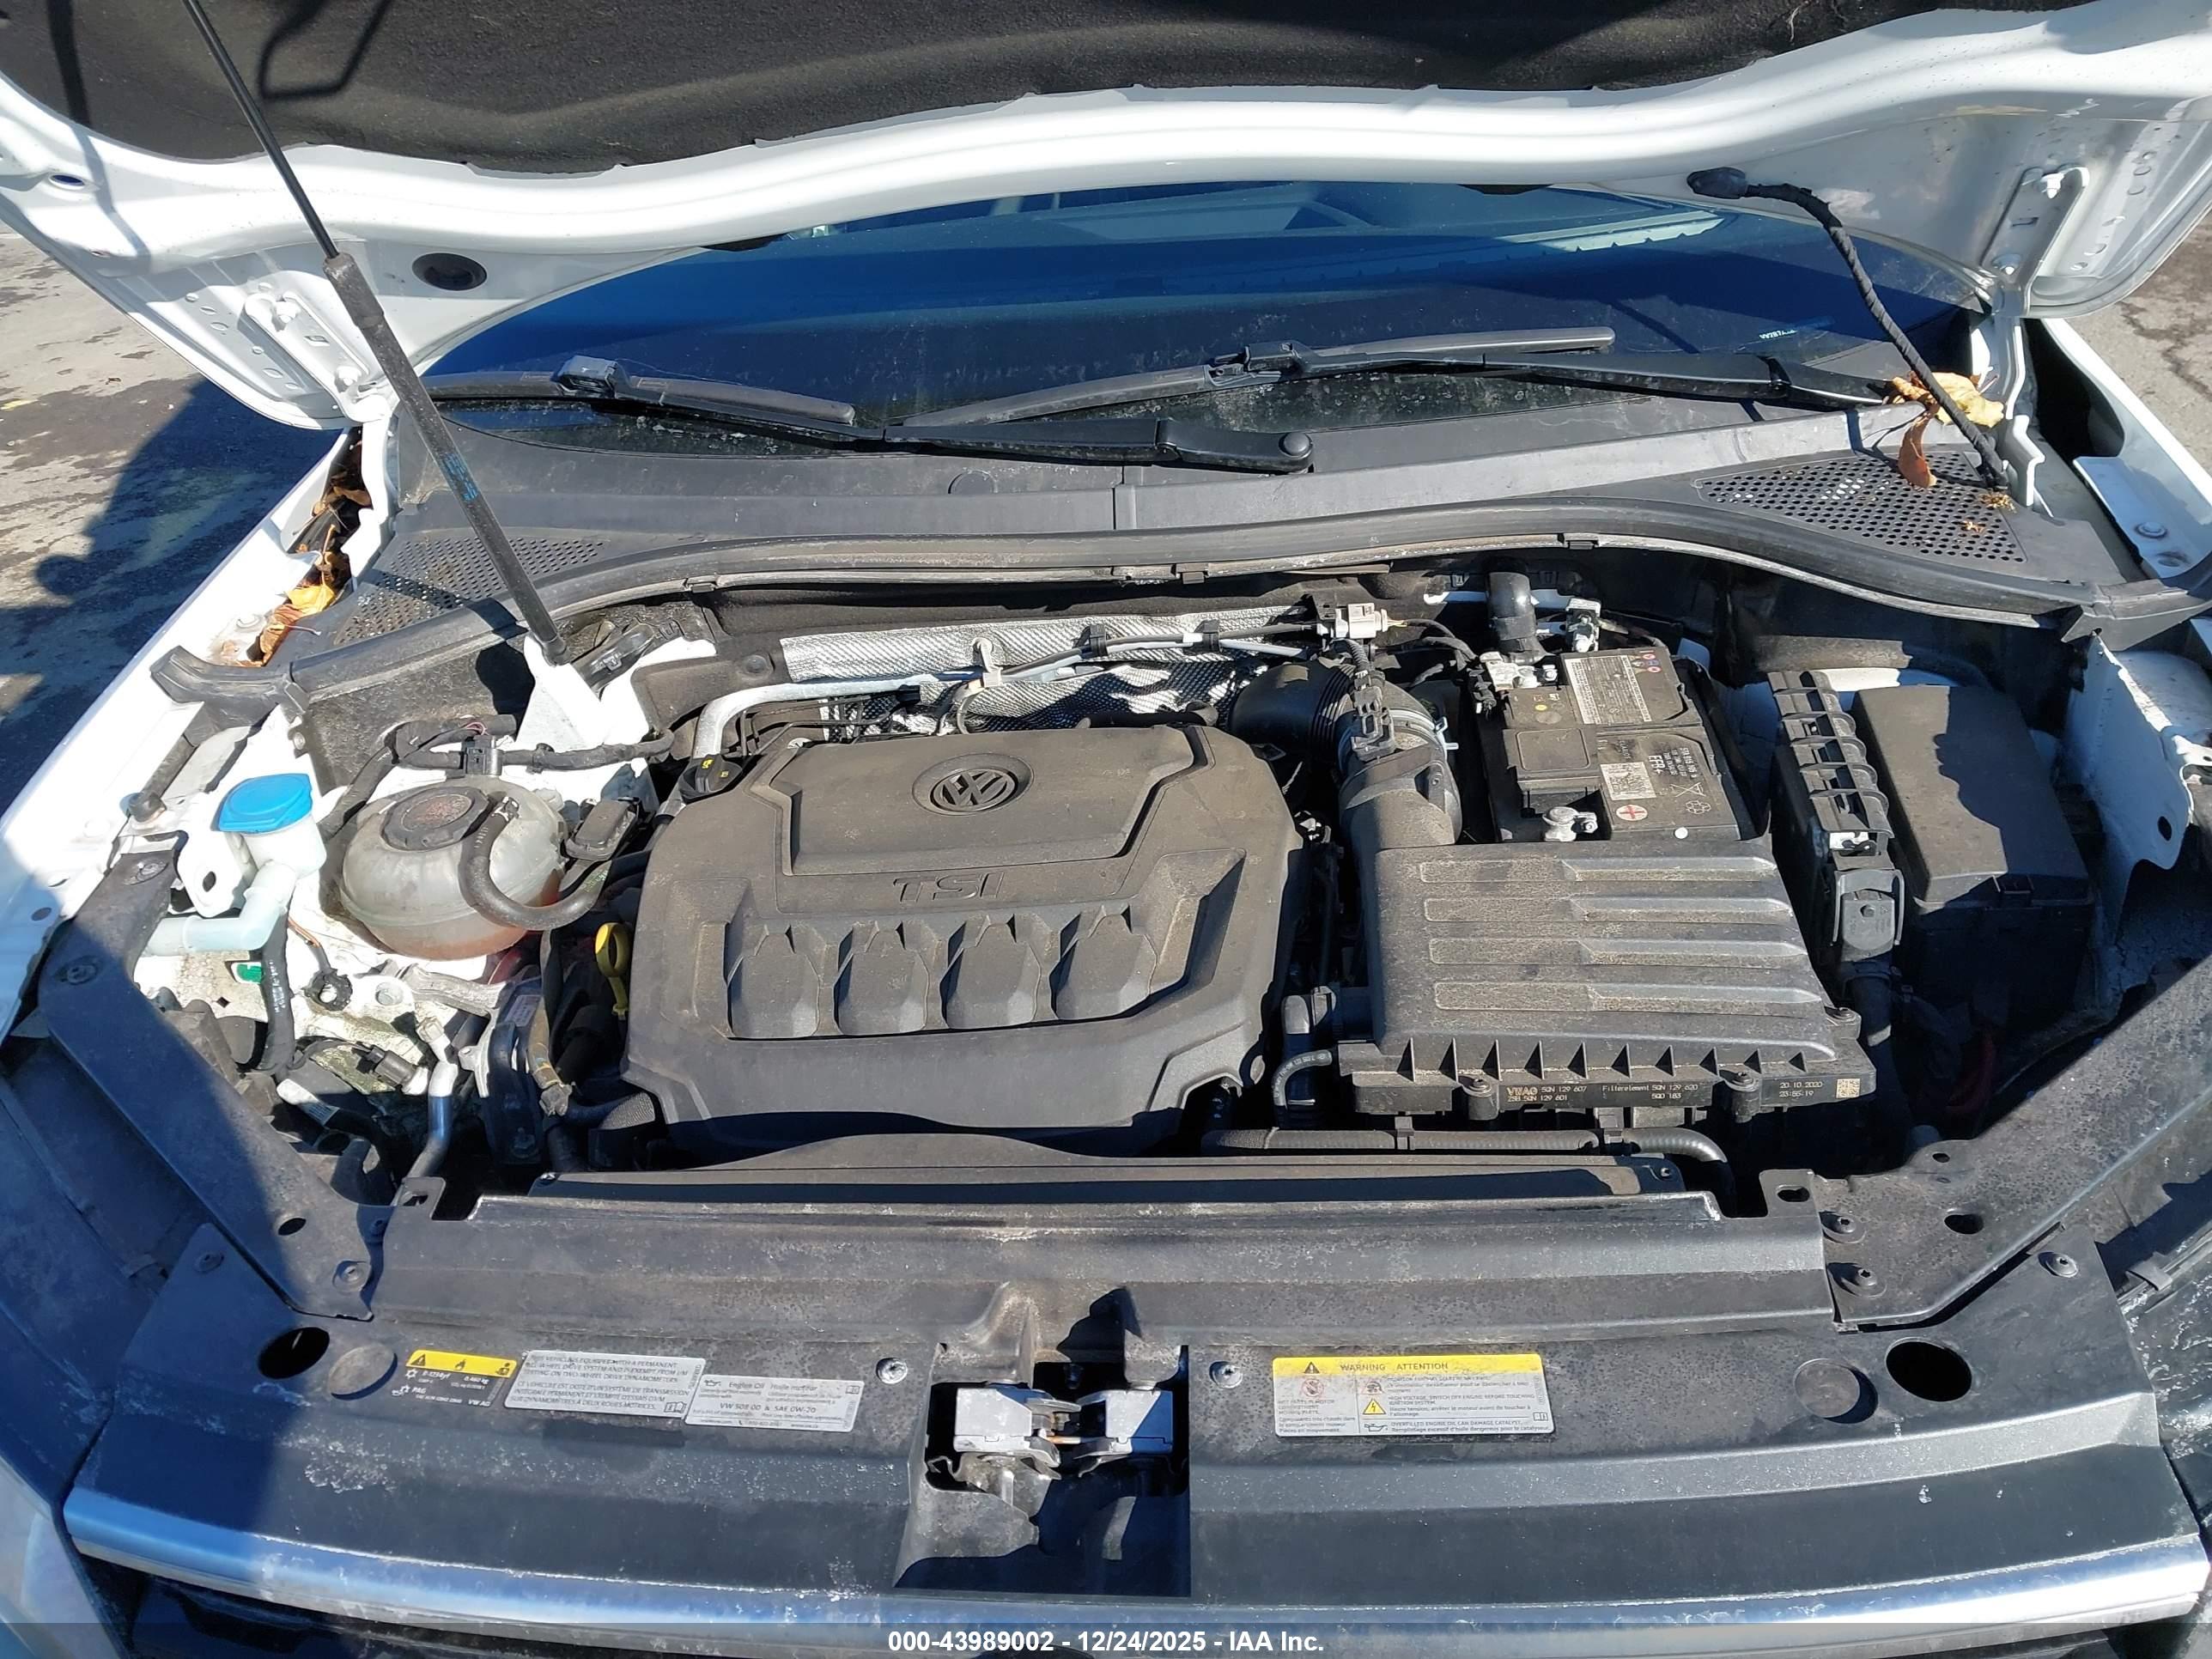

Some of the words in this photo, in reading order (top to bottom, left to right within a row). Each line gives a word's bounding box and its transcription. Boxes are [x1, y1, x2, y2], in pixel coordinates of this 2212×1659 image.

[1648, 755, 1666, 775] EFB+
[893, 872, 1005, 903] TSI
[1506, 1086, 1539, 1096] VWAG
